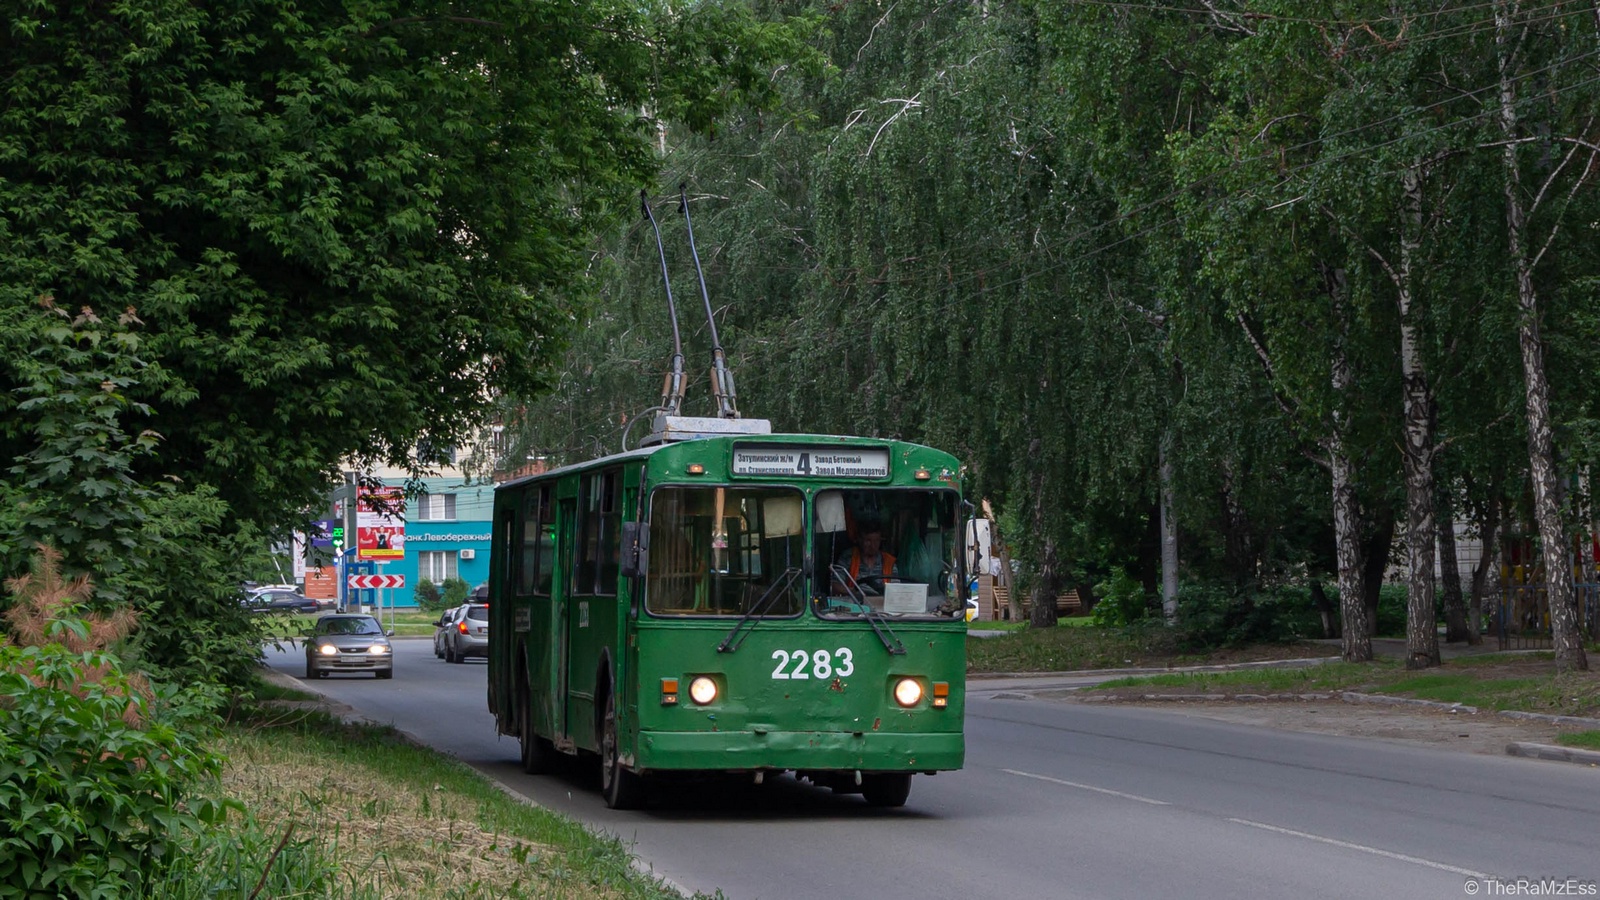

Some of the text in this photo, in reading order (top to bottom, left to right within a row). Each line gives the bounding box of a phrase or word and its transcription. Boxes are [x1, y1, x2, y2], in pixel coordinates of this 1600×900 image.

[737, 453, 794, 464] Затулинский ж/м
[796, 452, 812, 475] 4
[814, 455, 862, 464] Завод Бетонный
[815, 466, 886, 476] Завод Медпрепаратов
[424, 533, 492, 542] Левобережный
[771, 647, 854, 680] 2283
